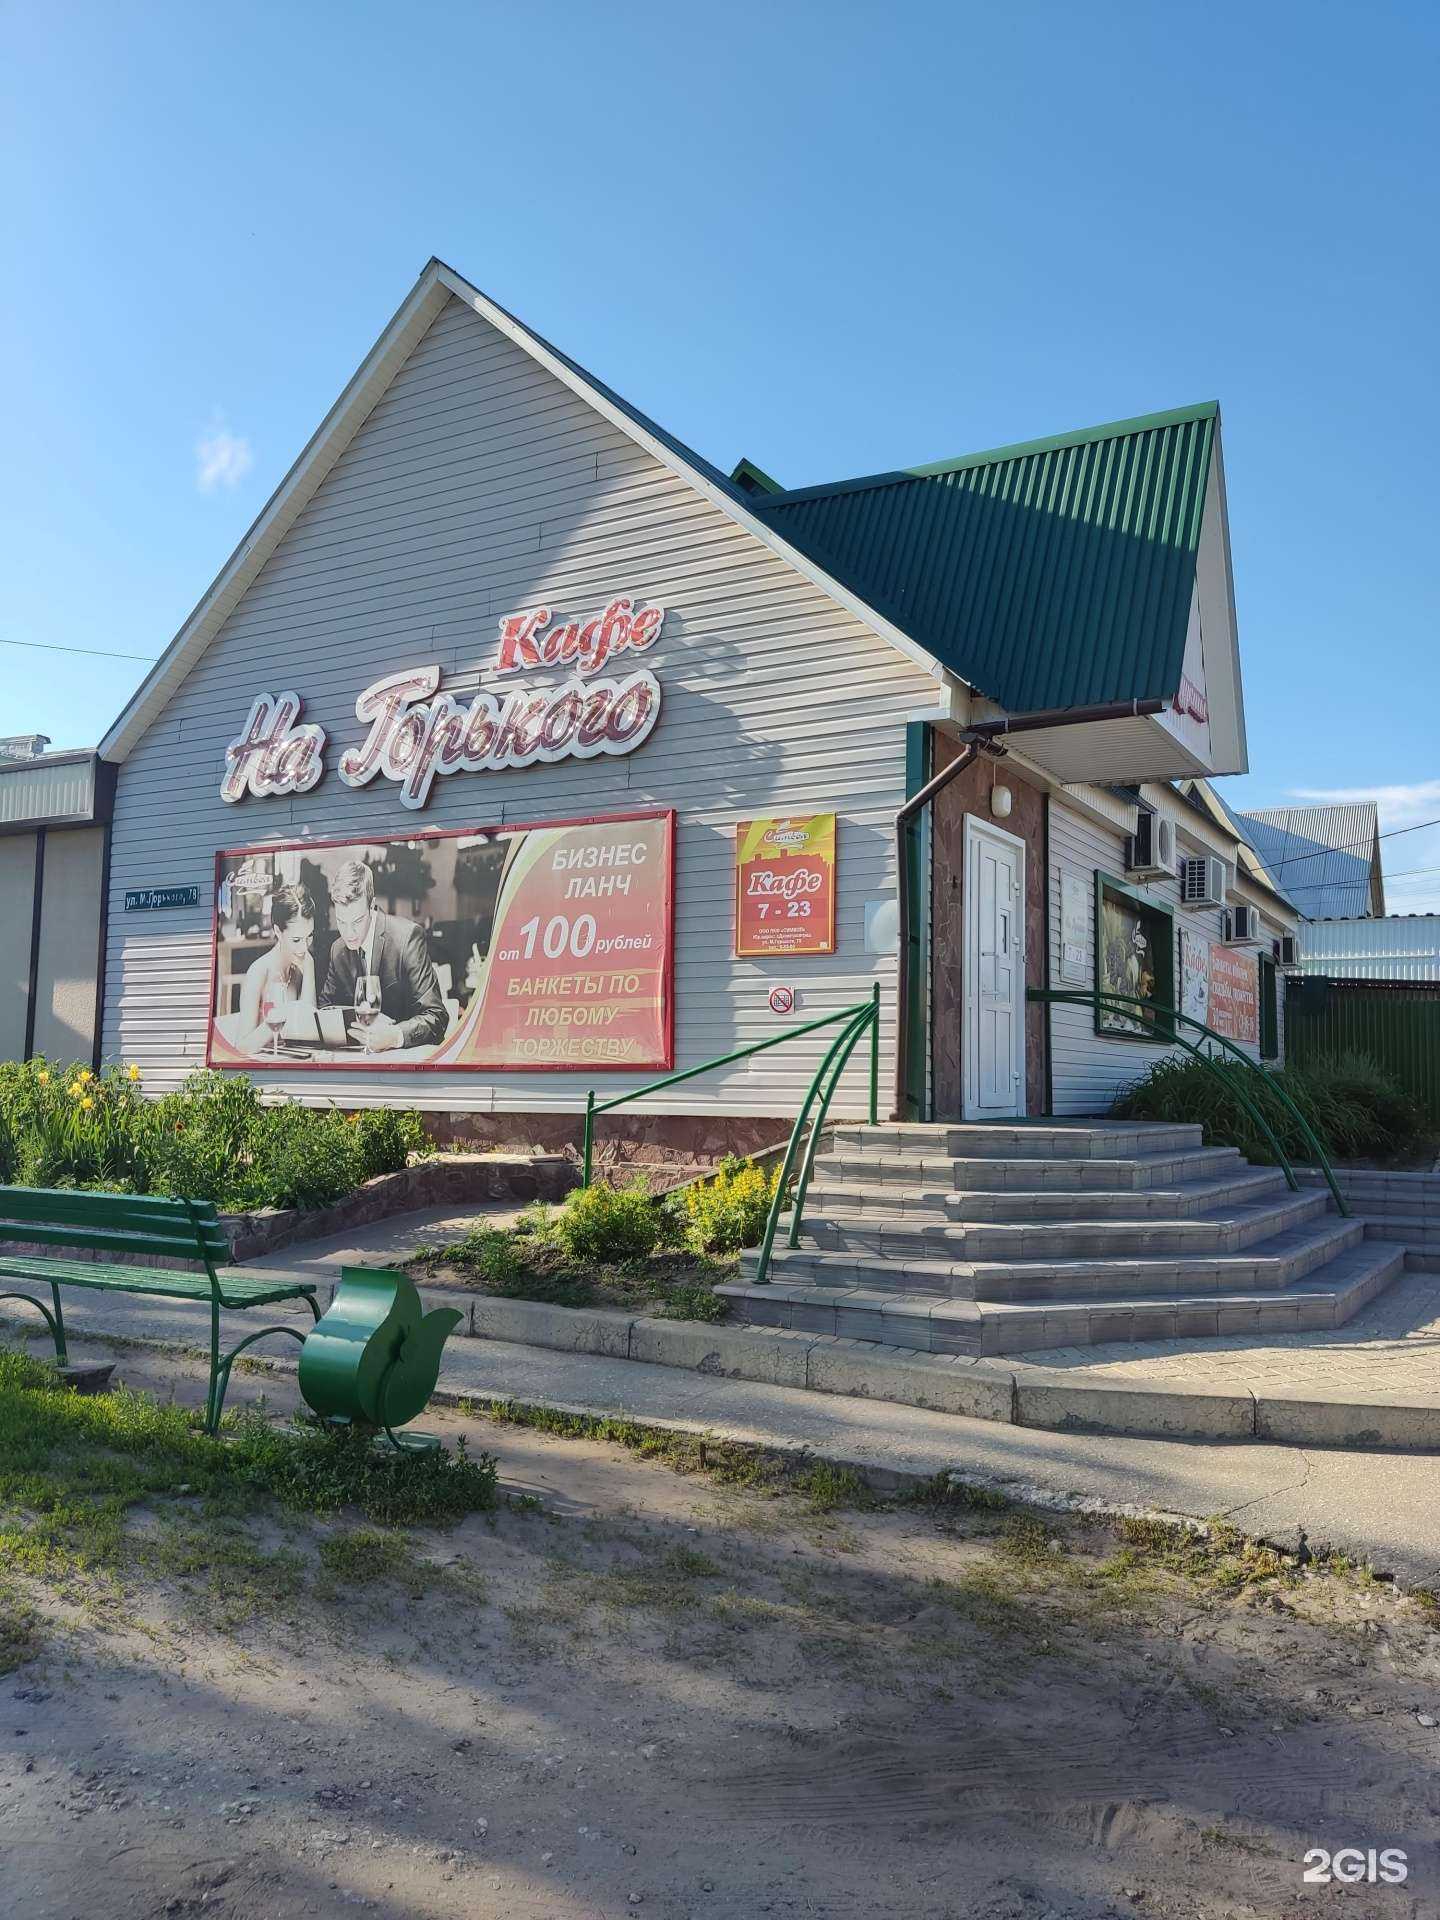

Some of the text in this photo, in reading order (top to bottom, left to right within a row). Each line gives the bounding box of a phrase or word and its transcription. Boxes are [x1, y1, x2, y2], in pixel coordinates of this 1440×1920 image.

[492, 595, 665, 676] Кафе
[221, 665, 660, 810] На Горького
[552, 842, 647, 871] БИЗНЕС
[564, 873, 632, 899] ЛАНЧ
[748, 869, 822, 899] Кафе
[757, 903, 770, 919] 7
[787, 902, 811, 918] 23
[498, 914, 652, 961] от 100 рублей
[507, 974, 640, 996] БАНКЕТЫ ПО
[525, 1006, 619, 1027] ЛЮБОМУ
[513, 1038, 634, 1057] ТОРЖЕСТВУ
